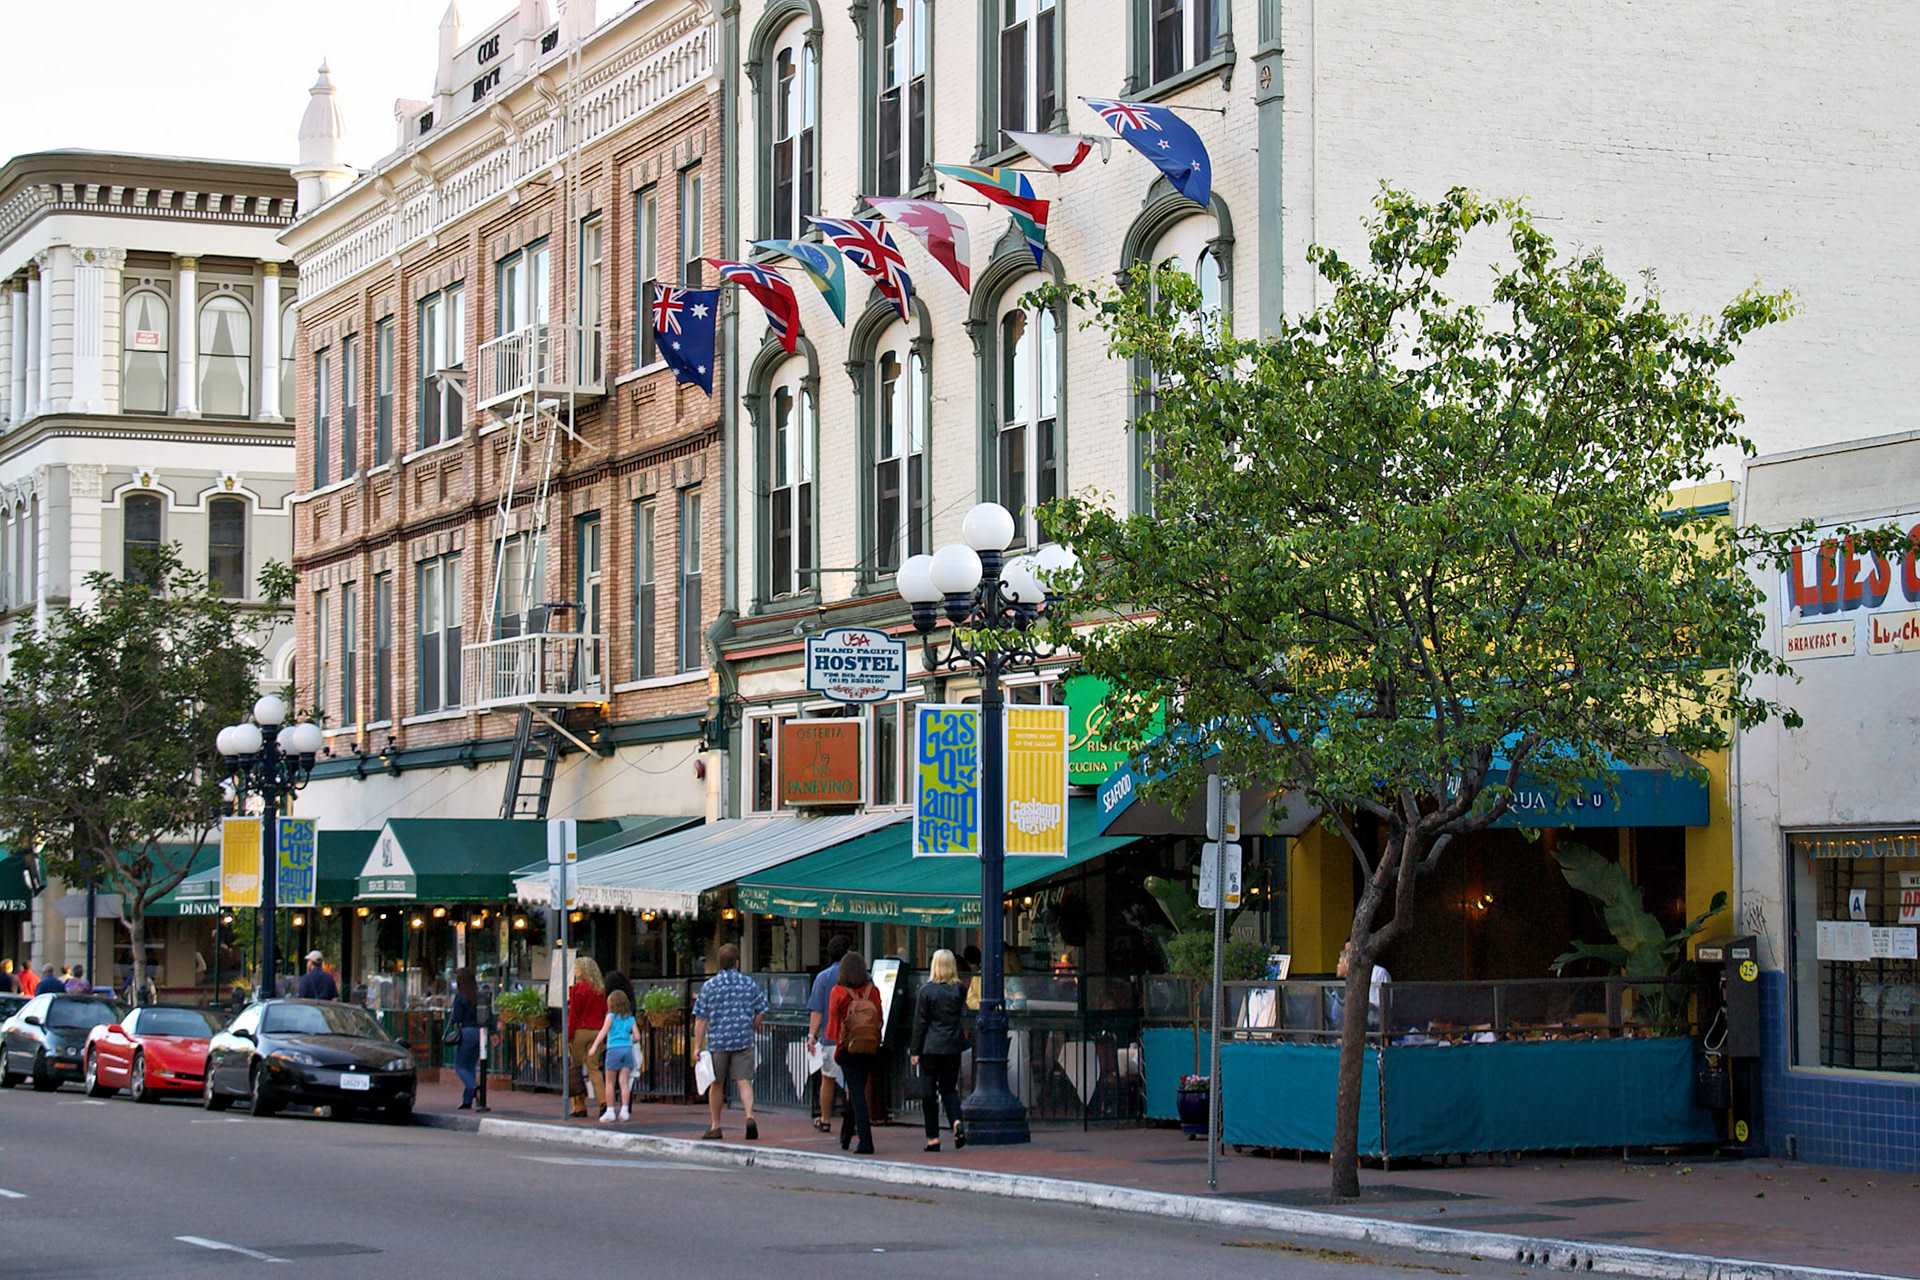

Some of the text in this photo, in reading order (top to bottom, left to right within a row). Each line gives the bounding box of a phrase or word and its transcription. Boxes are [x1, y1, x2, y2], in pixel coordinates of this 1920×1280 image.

[478, 34, 499, 65] COLE
[1788, 532, 1891, 613] LEES
[842, 633, 871, 647] USA
[1788, 633, 1837, 652] BREAKFAST
[814, 655, 899, 672] HOSTEL
[796, 727, 844, 739] OSTERIA
[919, 709, 976, 765] Gas
[1068, 761, 1108, 772] CUCINA
[788, 780, 853, 795] PANEVINO
[1102, 773, 1132, 813] SEAFOOD
[1009, 797, 1061, 824] Gaslamp
[1815, 836, 1864, 858] LEES
[849, 900, 899, 917] RISTORANTE
[1853, 896, 1861, 912] A
[1702, 950, 1718, 958] Phone
